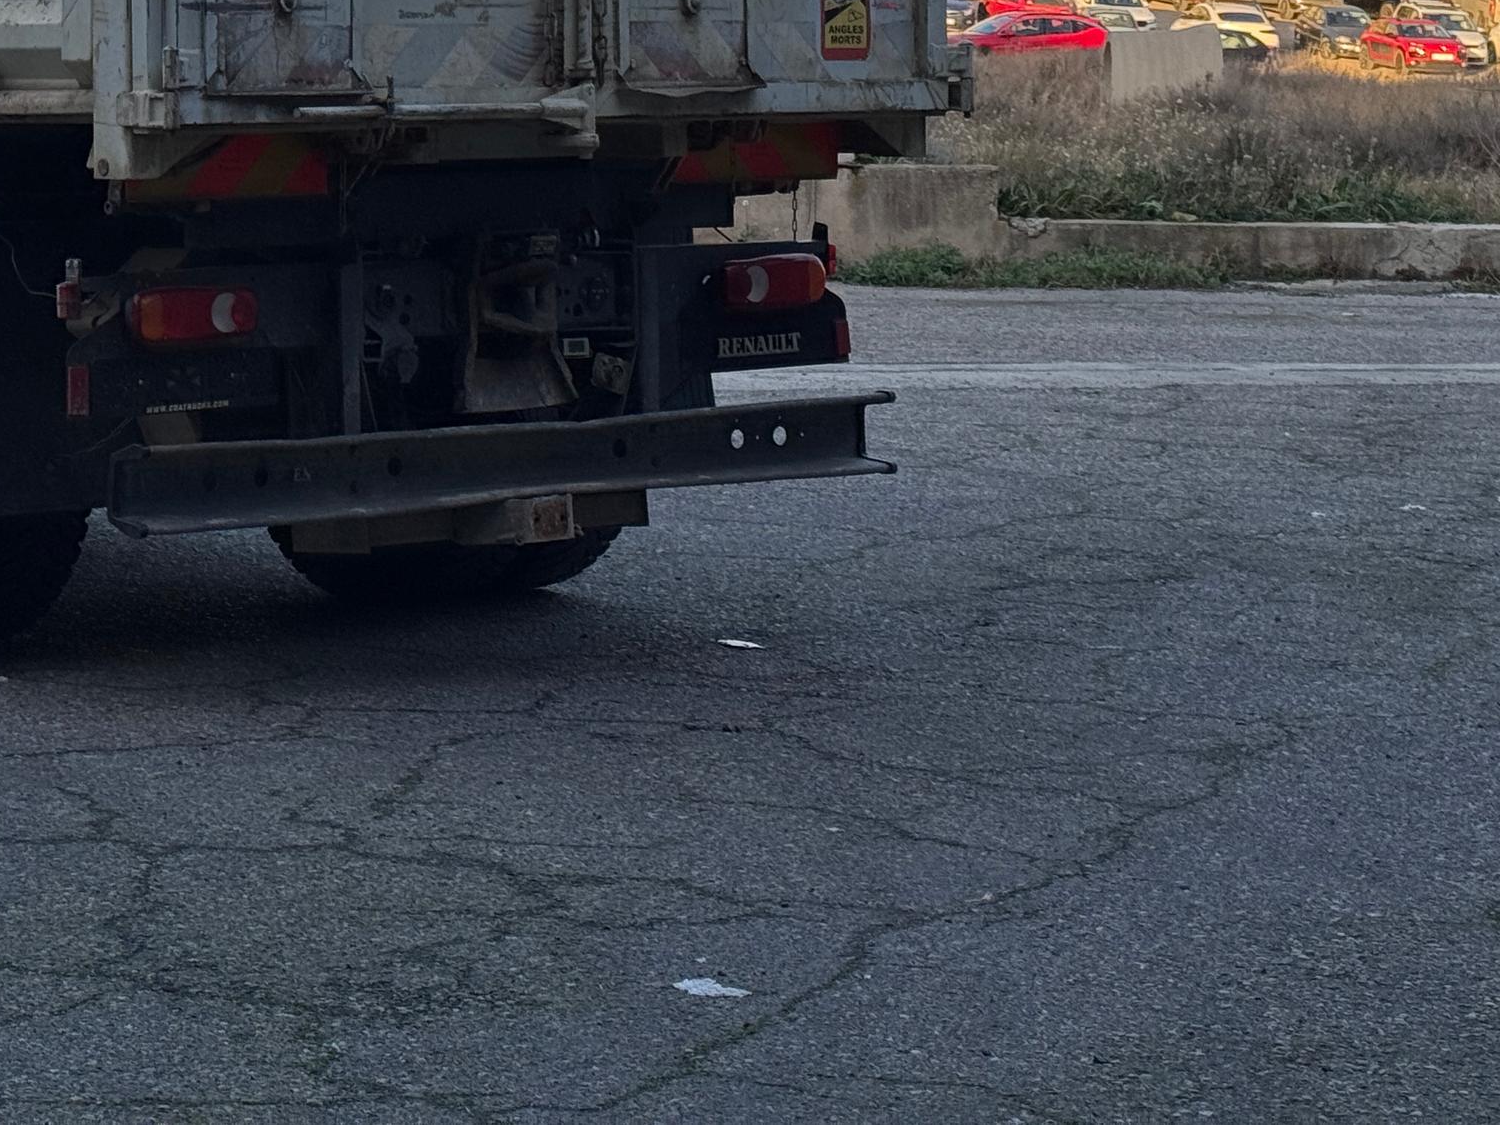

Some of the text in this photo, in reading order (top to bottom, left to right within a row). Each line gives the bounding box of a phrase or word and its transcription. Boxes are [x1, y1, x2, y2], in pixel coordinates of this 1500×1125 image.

[828, 25, 864, 34] ANGLES
[830, 35, 862, 45] MORTS
[717, 331, 801, 359] RENAULT
